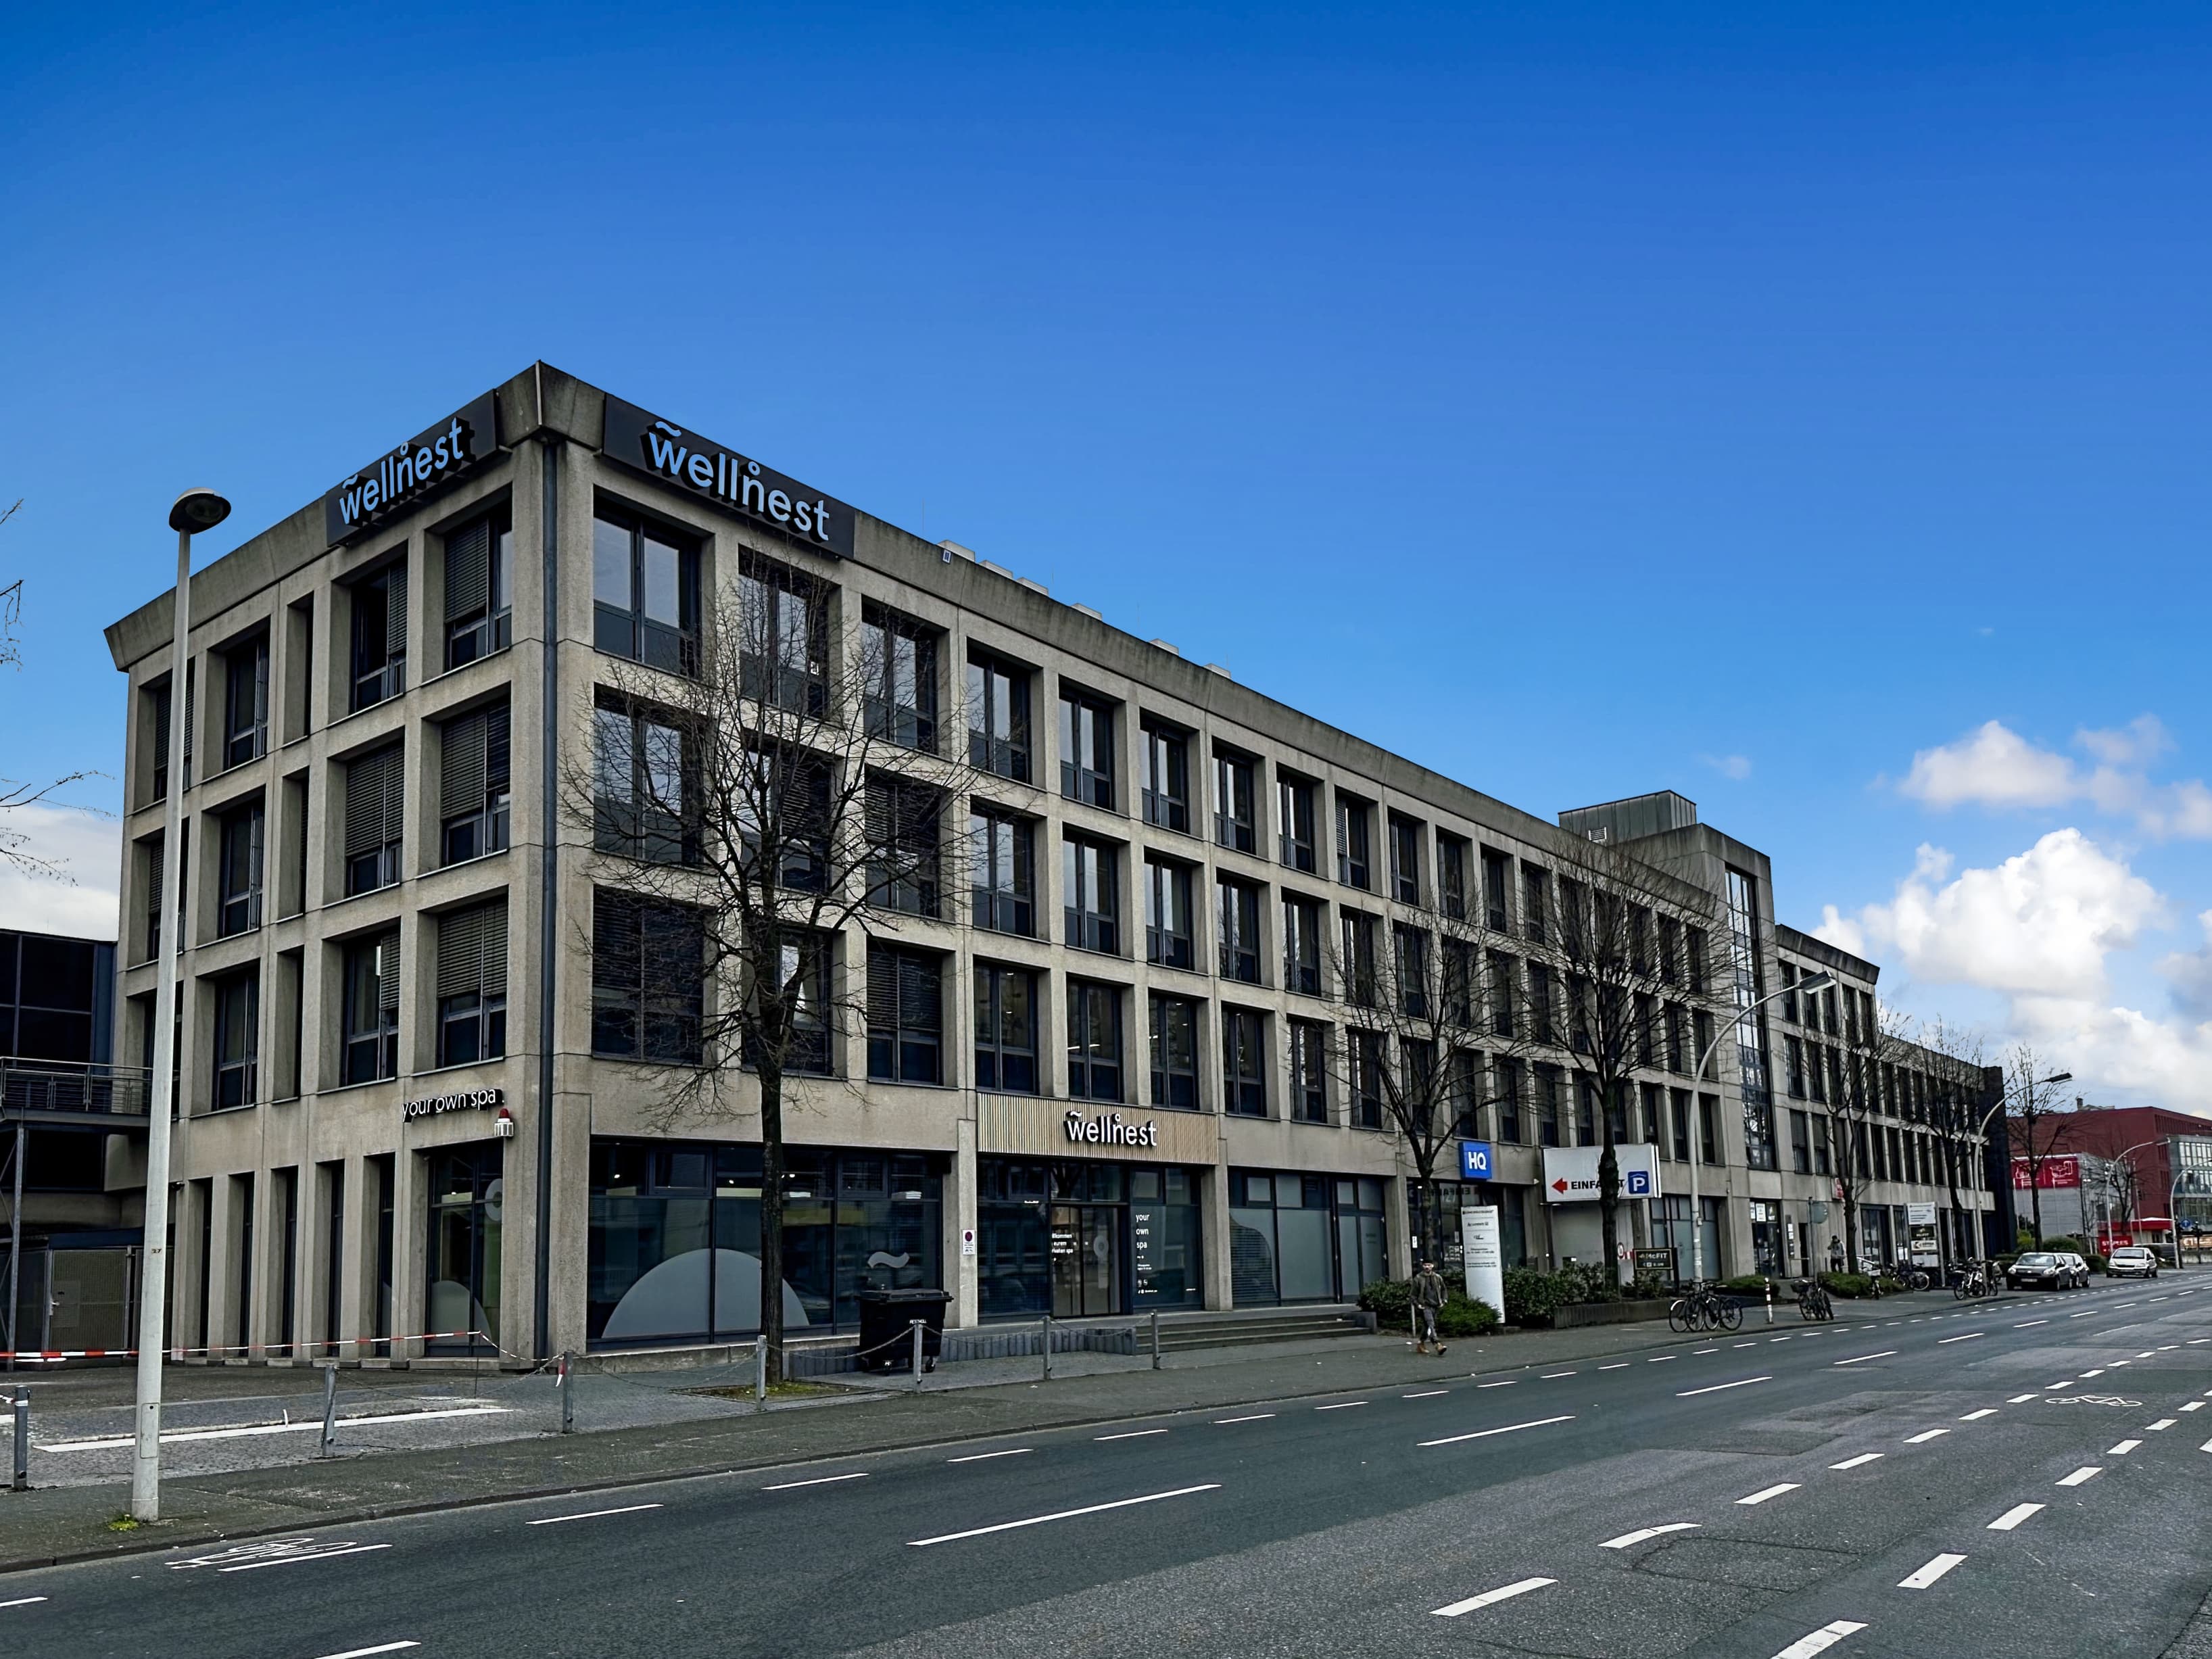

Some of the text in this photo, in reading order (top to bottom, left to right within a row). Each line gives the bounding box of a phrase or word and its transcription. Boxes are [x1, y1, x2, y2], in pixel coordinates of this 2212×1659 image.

[401, 1088, 496, 1123] your own spa
[1468, 1151, 1487, 1170] HQ
[1570, 1179, 1625, 1190] EINFAT
[1136, 1214, 1150, 1223] your
[1136, 1242, 1147, 1250] spa
